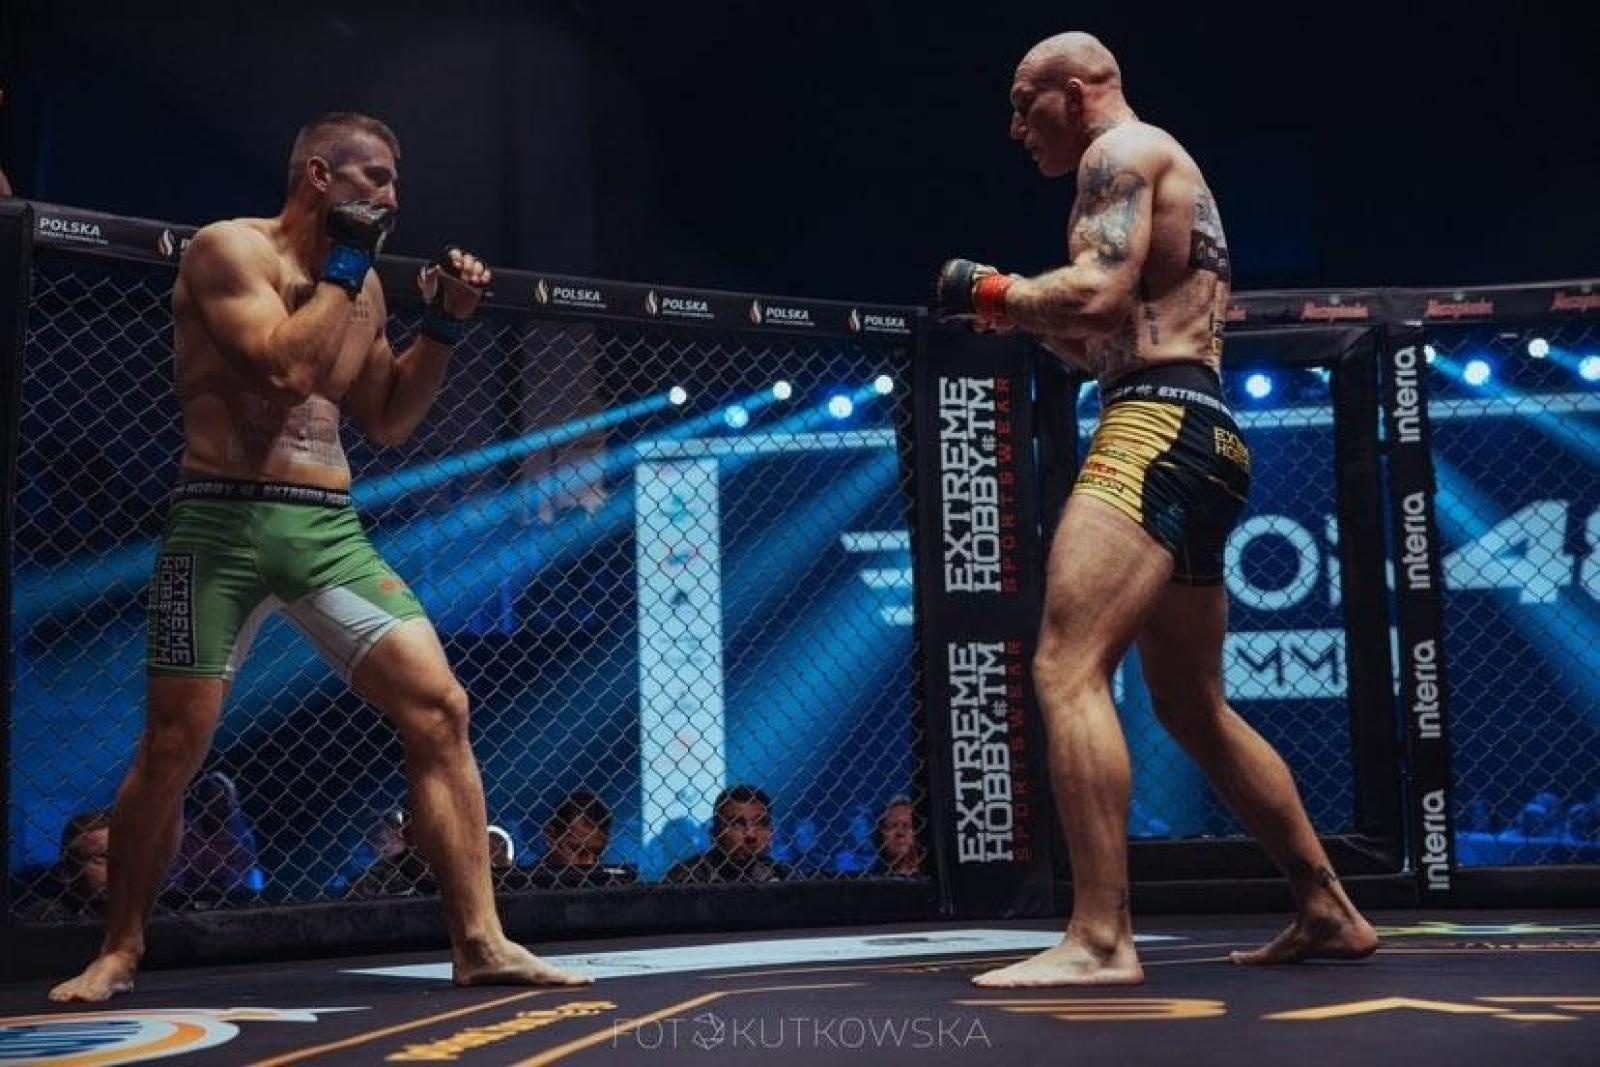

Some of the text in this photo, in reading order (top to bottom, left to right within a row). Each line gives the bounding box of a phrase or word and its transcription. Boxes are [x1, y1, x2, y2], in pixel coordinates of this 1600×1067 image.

[40, 217, 100, 236] POLSKA
[552, 286, 600, 301] POLSKA
[662, 297, 708, 312] POLSKA
[766, 306, 808, 320] POLSKA
[864, 315, 905, 328] POLSKA
[1393, 346, 1420, 442] interia
[939, 377, 973, 593] EXTREME
[1403, 491, 1430, 590] interia
[172, 556, 191, 664] EXTREME
[1413, 639, 1441, 739] interia
[949, 642, 986, 864] EXTREME
[1422, 788, 1449, 890] interia
